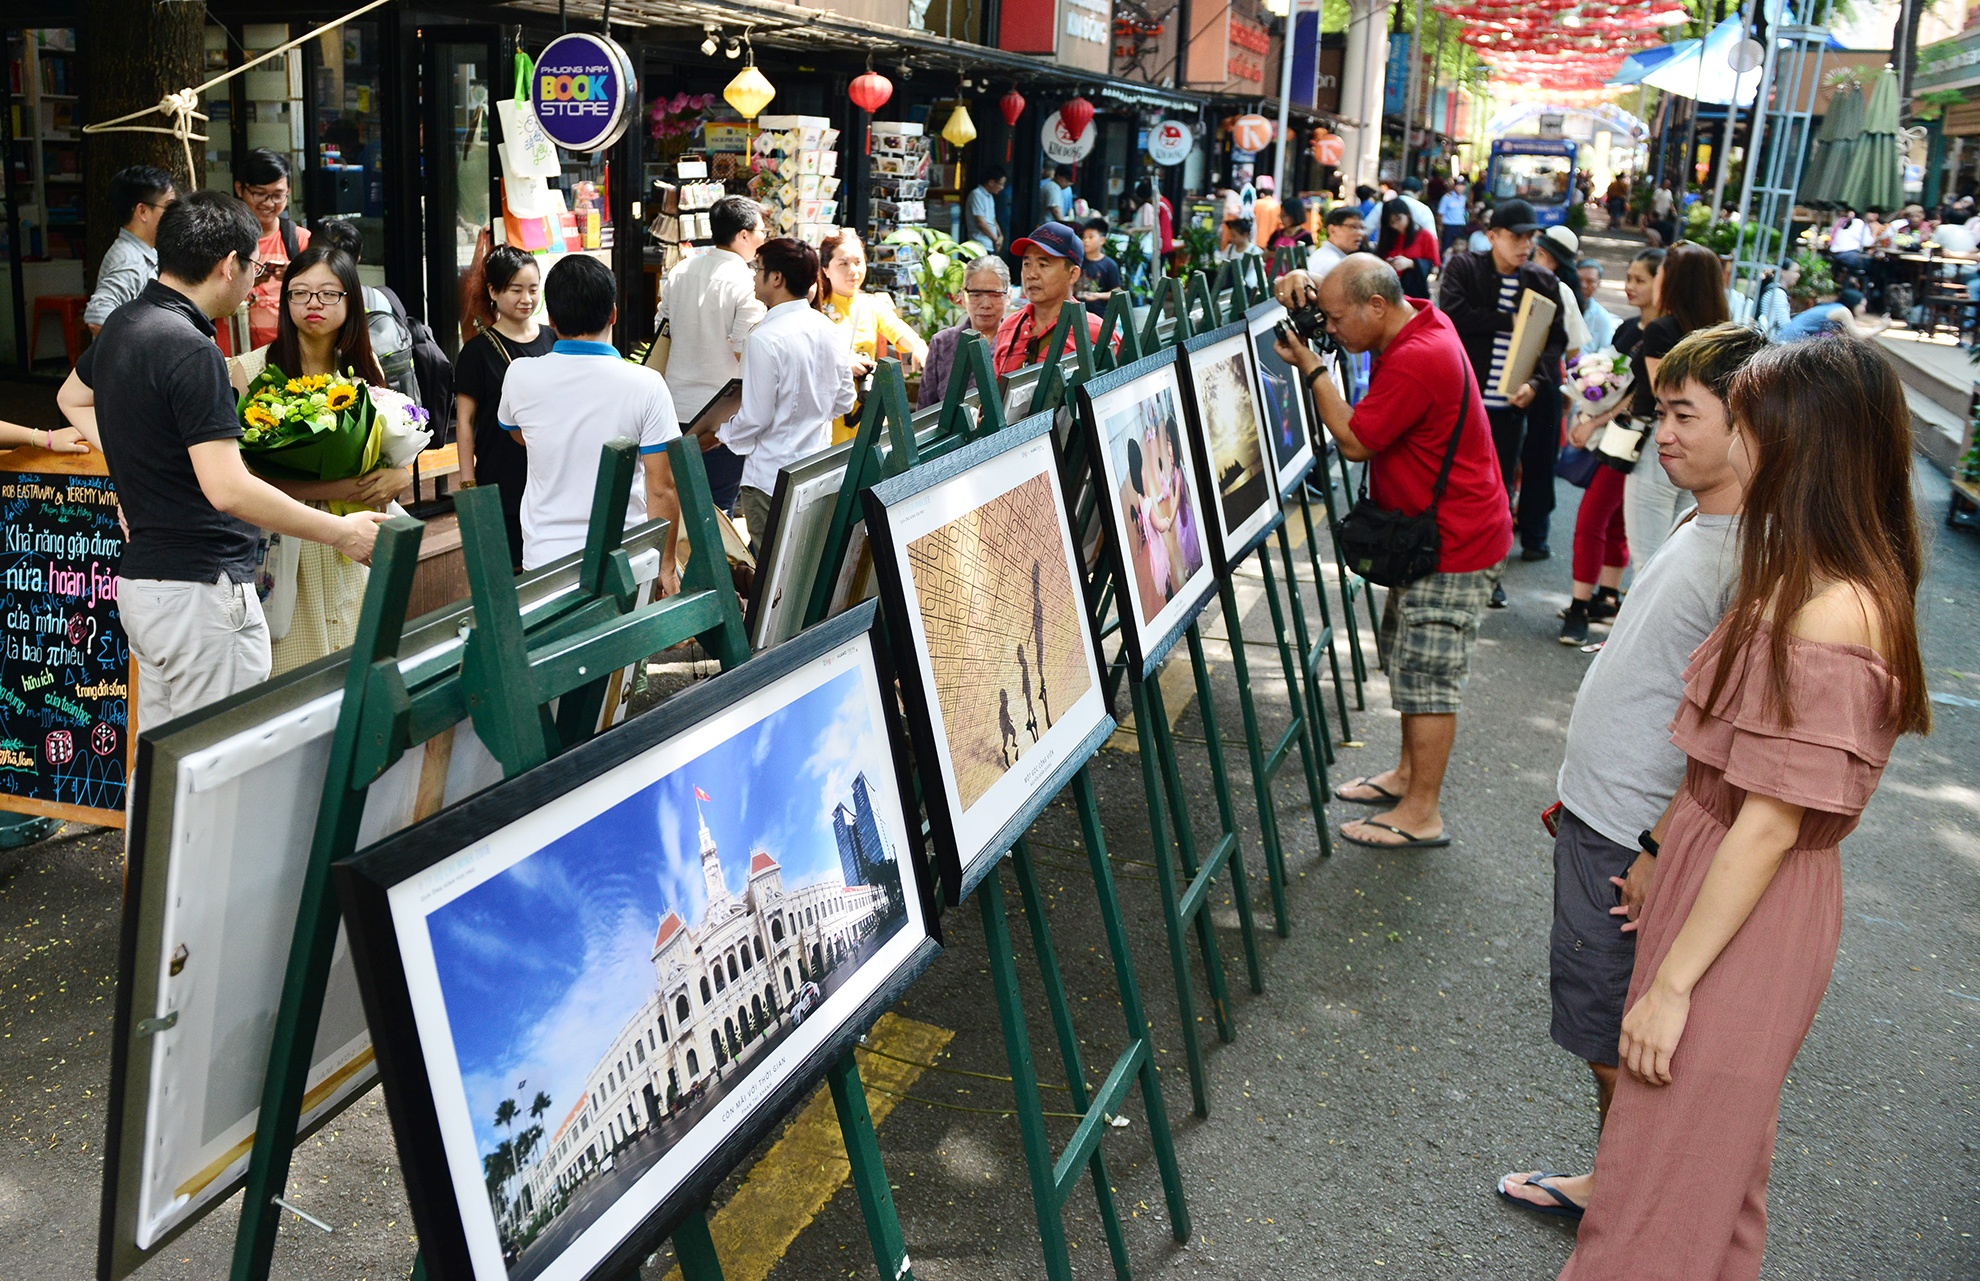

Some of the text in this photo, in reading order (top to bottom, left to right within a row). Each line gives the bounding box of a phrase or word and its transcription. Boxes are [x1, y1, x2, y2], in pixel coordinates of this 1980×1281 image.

[585, 65, 609, 74] NAM
[540, 75, 608, 101] BOOK
[540, 102, 609, 116] STORE
[2, 485, 15, 498] ROB
[17, 484, 55, 500] EASTAWAY
[54, 491, 64, 505] &
[67, 487, 97, 503] JEREMY
[6, 523, 121, 561] Khả năng gặp được
[7, 562, 42, 592] nửa
[49, 561, 86, 597] hoàn
[7, 604, 30, 630] của
[36, 604, 68, 635] mình
[7, 634, 18, 660] là
[22, 636, 42, 663] bao
[21, 667, 55, 692] hữu ích
[75, 678, 128, 701] trong đời sống
[5, 688, 27, 715] dụng
[44, 691, 61, 707] của
[60, 695, 79, 717] toán
[77, 703, 92, 725] học
[721, 1108, 735, 1122] CÒN
[736, 1094, 747, 1109] MÃI
[758, 1071, 772, 1086] THỜI
[772, 1056, 787, 1073] GIAN
